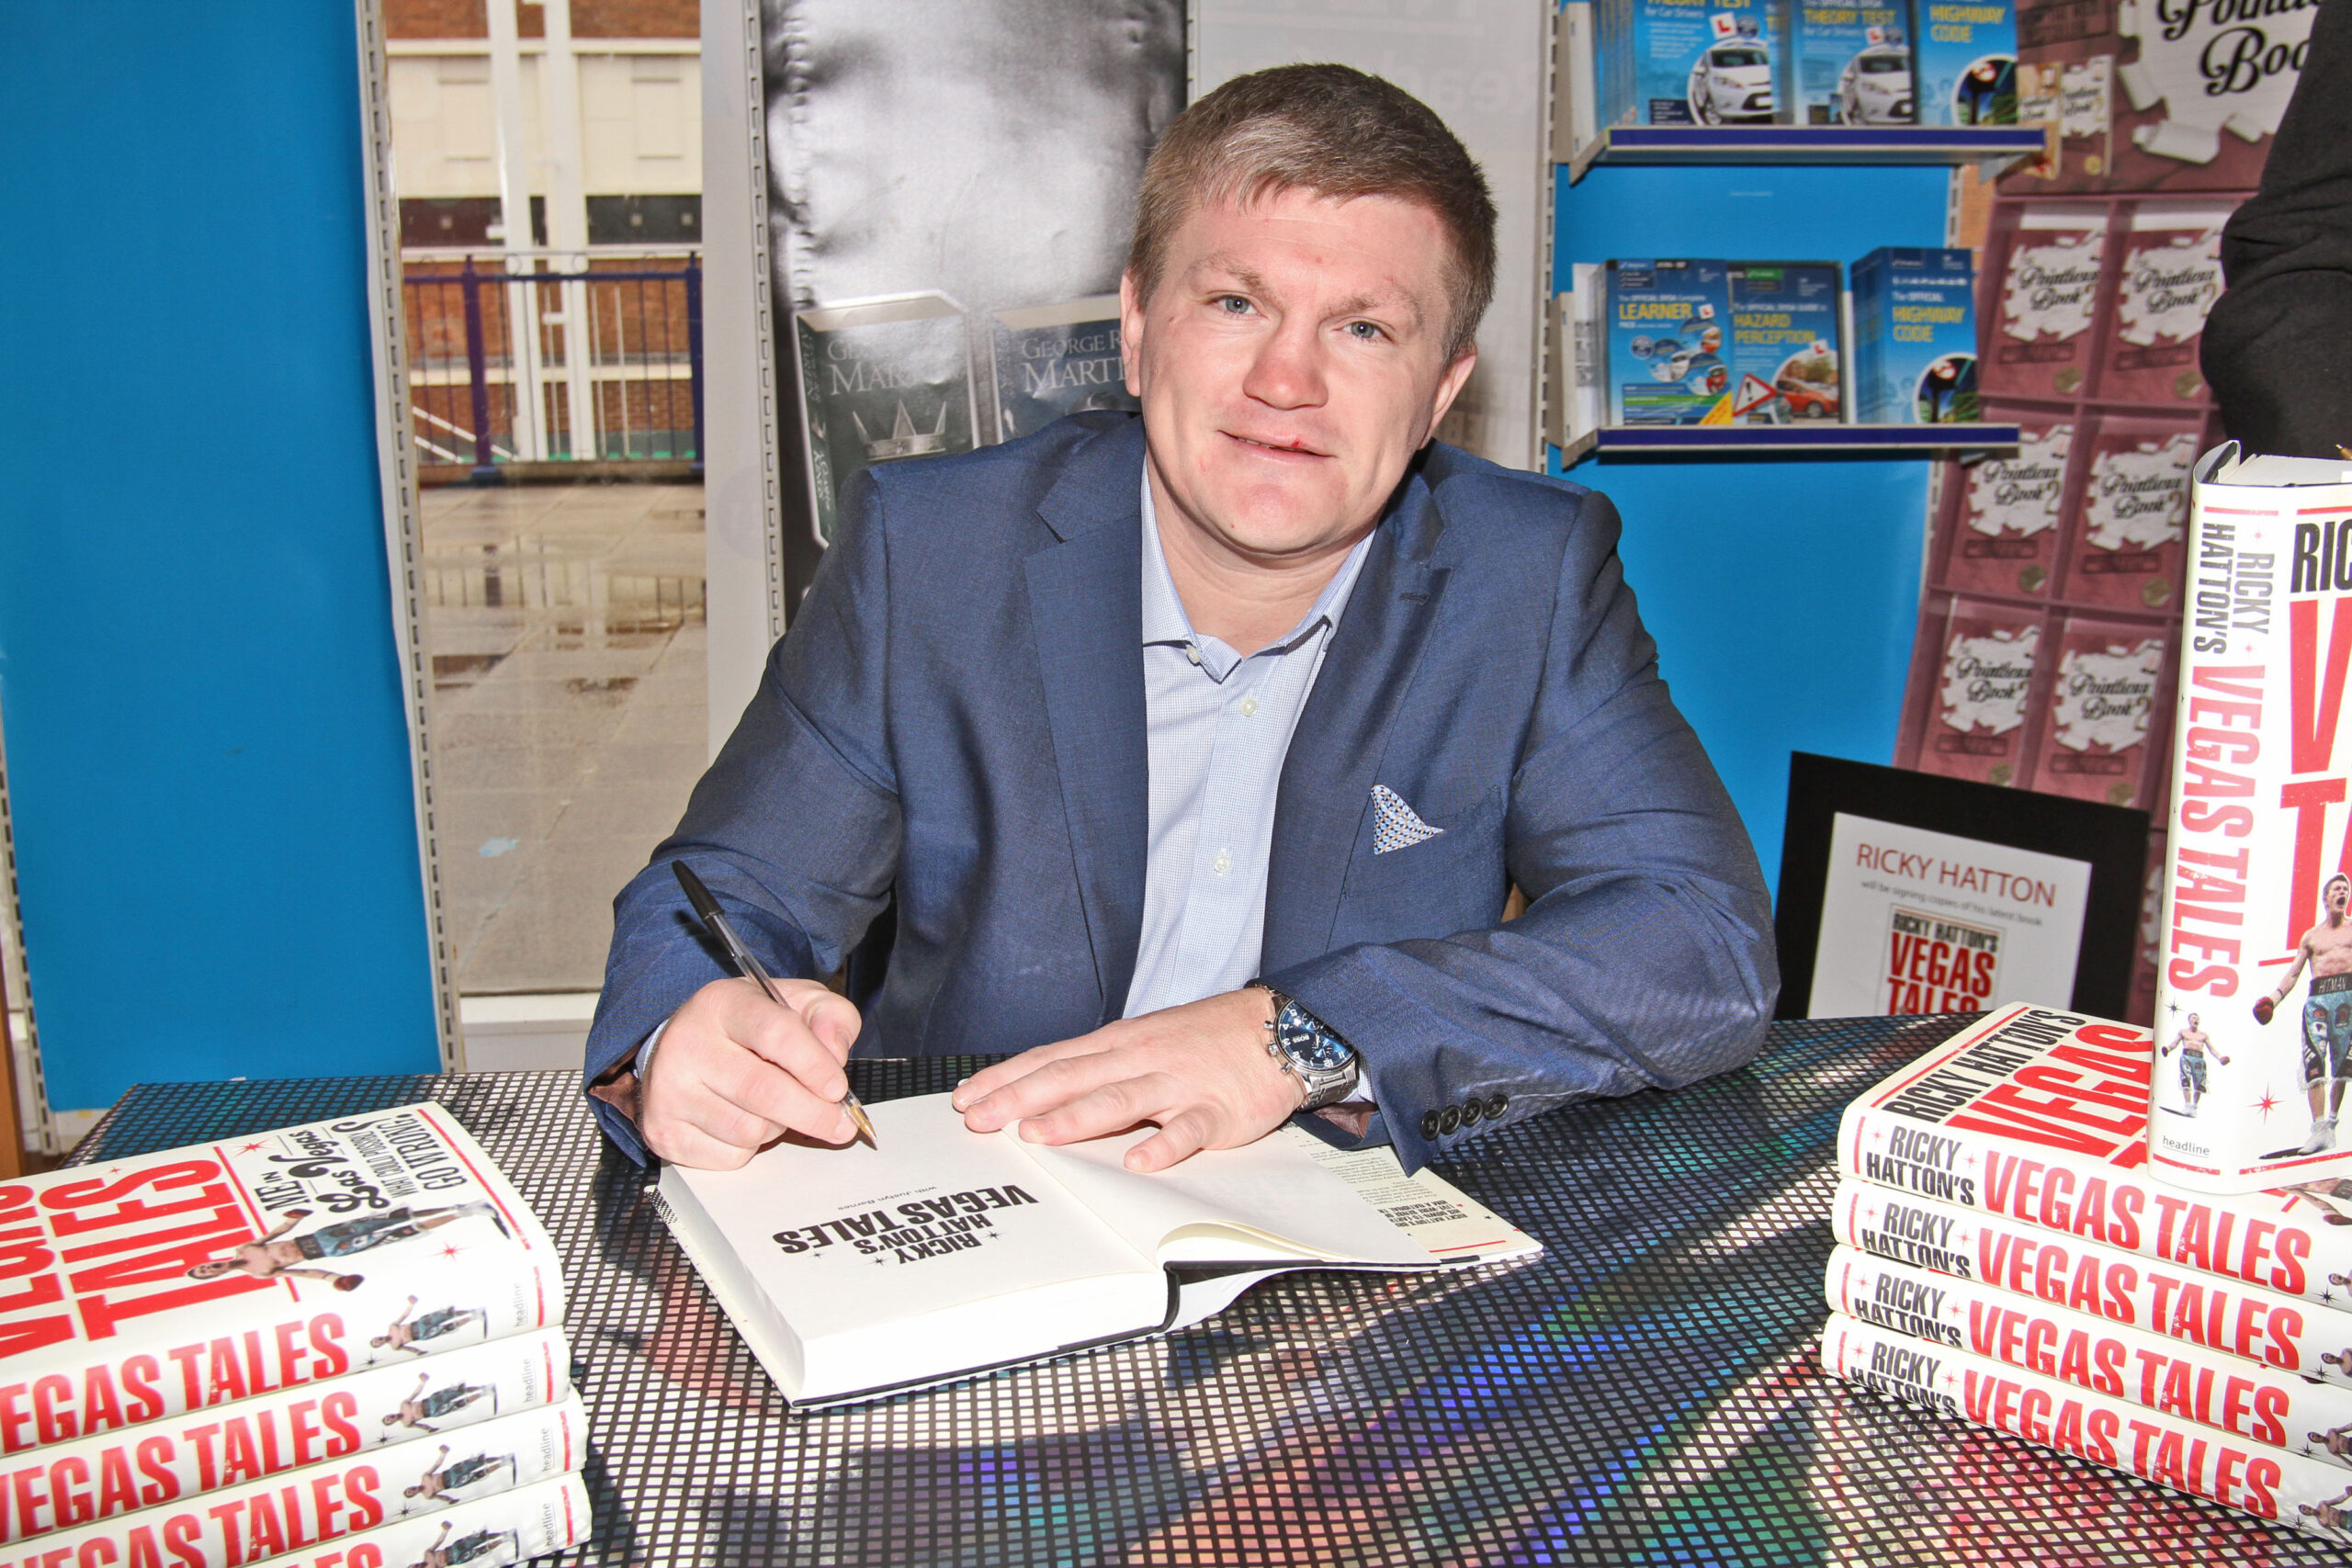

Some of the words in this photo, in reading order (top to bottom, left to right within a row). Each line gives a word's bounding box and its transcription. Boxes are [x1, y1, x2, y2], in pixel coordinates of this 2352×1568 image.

[1860, 10, 1896, 25] TEST
[1929, 5, 2006, 25] HIGHWAY
[1930, 24, 1973, 43] CODE
[2199, 26, 2310, 96] Boo
[1619, 302, 1693, 320] LEARNER
[1734, 312, 1792, 328] HAZARD
[1893, 306, 1965, 323] HIGHWAY
[1894, 324, 1935, 343] CODE
[1735, 329, 1816, 344] PERCEPTION
[1022, 356, 1126, 392] MARTI
[2193, 522, 2235, 654] HATTON'S
[2232, 552, 2275, 635] RICKY
[2178, 665, 2266, 840] VEGAS
[1856, 843, 1934, 880] RICKY
[1939, 861, 2056, 908] HATTON
[1861, 880, 1877, 889] will
[1878, 883, 1889, 893] be
[1892, 886, 1927, 903] signing
[1928, 895, 1958, 909] copies
[1988, 906, 2014, 920] latest
[2016, 911, 2043, 927] book
[2168, 846, 2249, 998] TALES
[1893, 912, 1933, 940] RICKY
[1935, 920, 1999, 953] HATTON'S
[1891, 931, 1996, 998] VEGAS
[1292, 1033, 1310, 1043] BOSS
[1882, 1066, 1983, 1125] RICKY
[1965, 1010, 2087, 1088] HATTON'S
[267, 1130, 350, 1179] Vegas
[346, 1130, 389, 1158] POSSIBLY
[366, 1154, 405, 1179] COULD
[1889, 1124, 1963, 1169] RICKY
[2163, 1135, 2211, 1156] headline
[254, 1180, 312, 1212] ME
[261, 1171, 283, 1183] IN
[315, 1169, 390, 1213] Las
[380, 1176, 419, 1199] WHAT
[415, 1167, 468, 1190] GO
[877, 1190, 911, 1201] Justyn
[1865, 1152, 1975, 1207] HATTON'S
[837, 1199, 876, 1211] Barnes
[896, 1184, 1040, 1225] VEGAS
[1883, 1201, 1955, 1247] RICKY
[1984, 1149, 2146, 1251] VEGAS
[2154, 1194, 2312, 1296] TALES
[39, 1159, 278, 1342] TALES
[772, 1210, 906, 1255] TALES
[852, 1213, 994, 1255] HATTON'S
[896, 1232, 983, 1265] RICKY
[1860, 1228, 1970, 1279] HATTON'S
[514, 1282, 527, 1328] headline
[1874, 1271, 1947, 1317] RICKY
[1978, 1227, 2138, 1325] VEGAS
[2146, 1271, 2304, 1371] TALES
[1853, 1297, 1962, 1348] HATTON'S
[169, 1312, 350, 1412] TALES
[524, 1358, 533, 1404] headline
[1871, 1341, 1941, 1387] RICKY
[1968, 1299, 2127, 1399] VEGAS
[2134, 1348, 2290, 1449] TALES
[1849, 1366, 1956, 1419] HATTON'S
[183, 1390, 363, 1493] TALES
[542, 1427, 552, 1473] headline
[1962, 1369, 2120, 1469] VEGAS
[2127, 1419, 2282, 1520] TALES
[22, 1514, 208, 1568] GAS
[209, 1464, 384, 1568] TALES
[544, 1502, 554, 1548] headline
